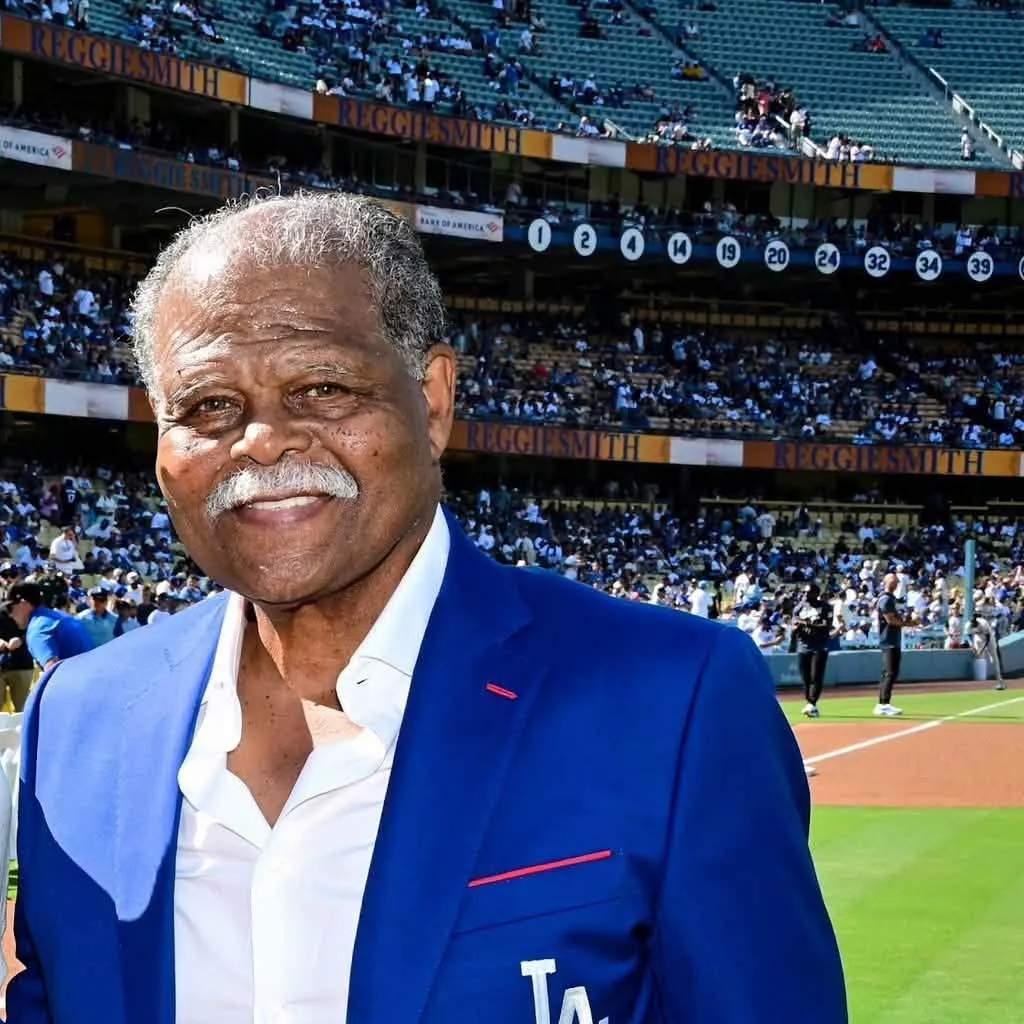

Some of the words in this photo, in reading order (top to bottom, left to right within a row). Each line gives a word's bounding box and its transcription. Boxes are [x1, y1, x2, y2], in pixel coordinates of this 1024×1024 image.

[30, 26, 135, 77] REGGIE
[137, 51, 219, 97] SMITH
[3, 140, 13, 151] OF
[15, 143, 49, 157] AMERICA
[420, 217, 440, 228] BANK
[441, 220, 450, 229] OF
[451, 221, 484, 232] AMERICA
[536, 226, 543, 244] 1
[581, 231, 590, 249] 2
[627, 235, 637, 253] 4
[672, 239, 687, 257] 14
[721, 243, 736, 261] 19
[767, 247, 786, 264] 20
[818, 250, 838, 267] 24
[867, 253, 887, 271] 32
[919, 256, 940, 273] 34
[970, 258, 991, 275] 39
